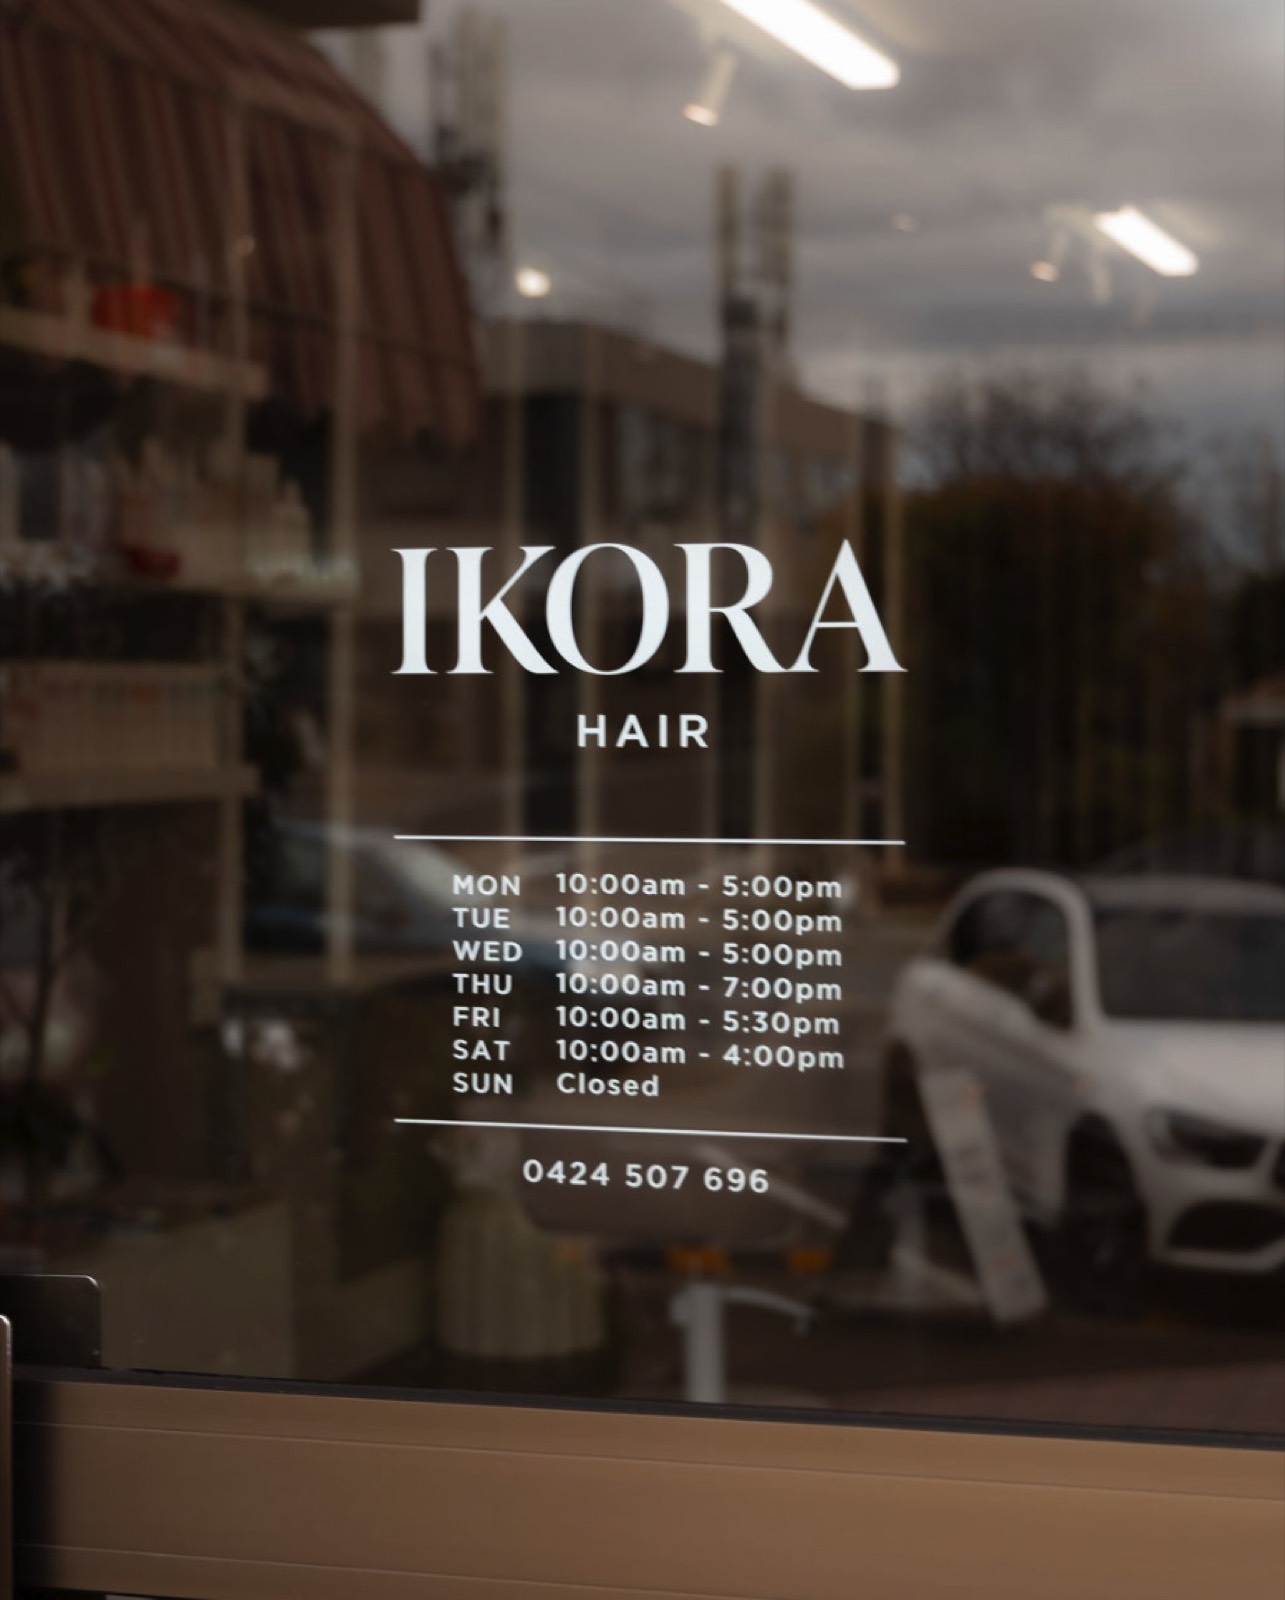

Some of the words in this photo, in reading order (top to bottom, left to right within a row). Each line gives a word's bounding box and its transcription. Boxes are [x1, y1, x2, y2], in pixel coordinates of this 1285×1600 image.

[390, 538, 909, 676] IKORA
[576, 713, 709, 749] HAIR
[452, 874, 521, 896] MON
[555, 872, 686, 896] 10:00am
[722, 874, 843, 902] 5:00pm
[452, 907, 511, 929] TUE
[555, 906, 686, 930] 10:00am
[722, 908, 843, 936] 5:00pm
[452, 939, 523, 962] WED
[555, 939, 686, 963] 10:00am
[722, 942, 843, 970] 5:00pm
[451, 972, 513, 996] THU
[555, 971, 686, 997] 10:00am
[722, 976, 843, 1005] 7:00pm
[452, 1005, 500, 1028] FRI
[555, 1004, 686, 1031] 10:00am
[722, 1009, 840, 1038] 5:30pm
[452, 1038, 511, 1062] SAT
[555, 1038, 686, 1064] 10:00am
[721, 1043, 845, 1073] 4:00pm
[452, 1071, 513, 1095] SUN
[556, 1072, 659, 1097] Closed
[522, 1158, 611, 1187] 0424
[624, 1163, 690, 1190] 507
[703, 1166, 770, 1194] 696
